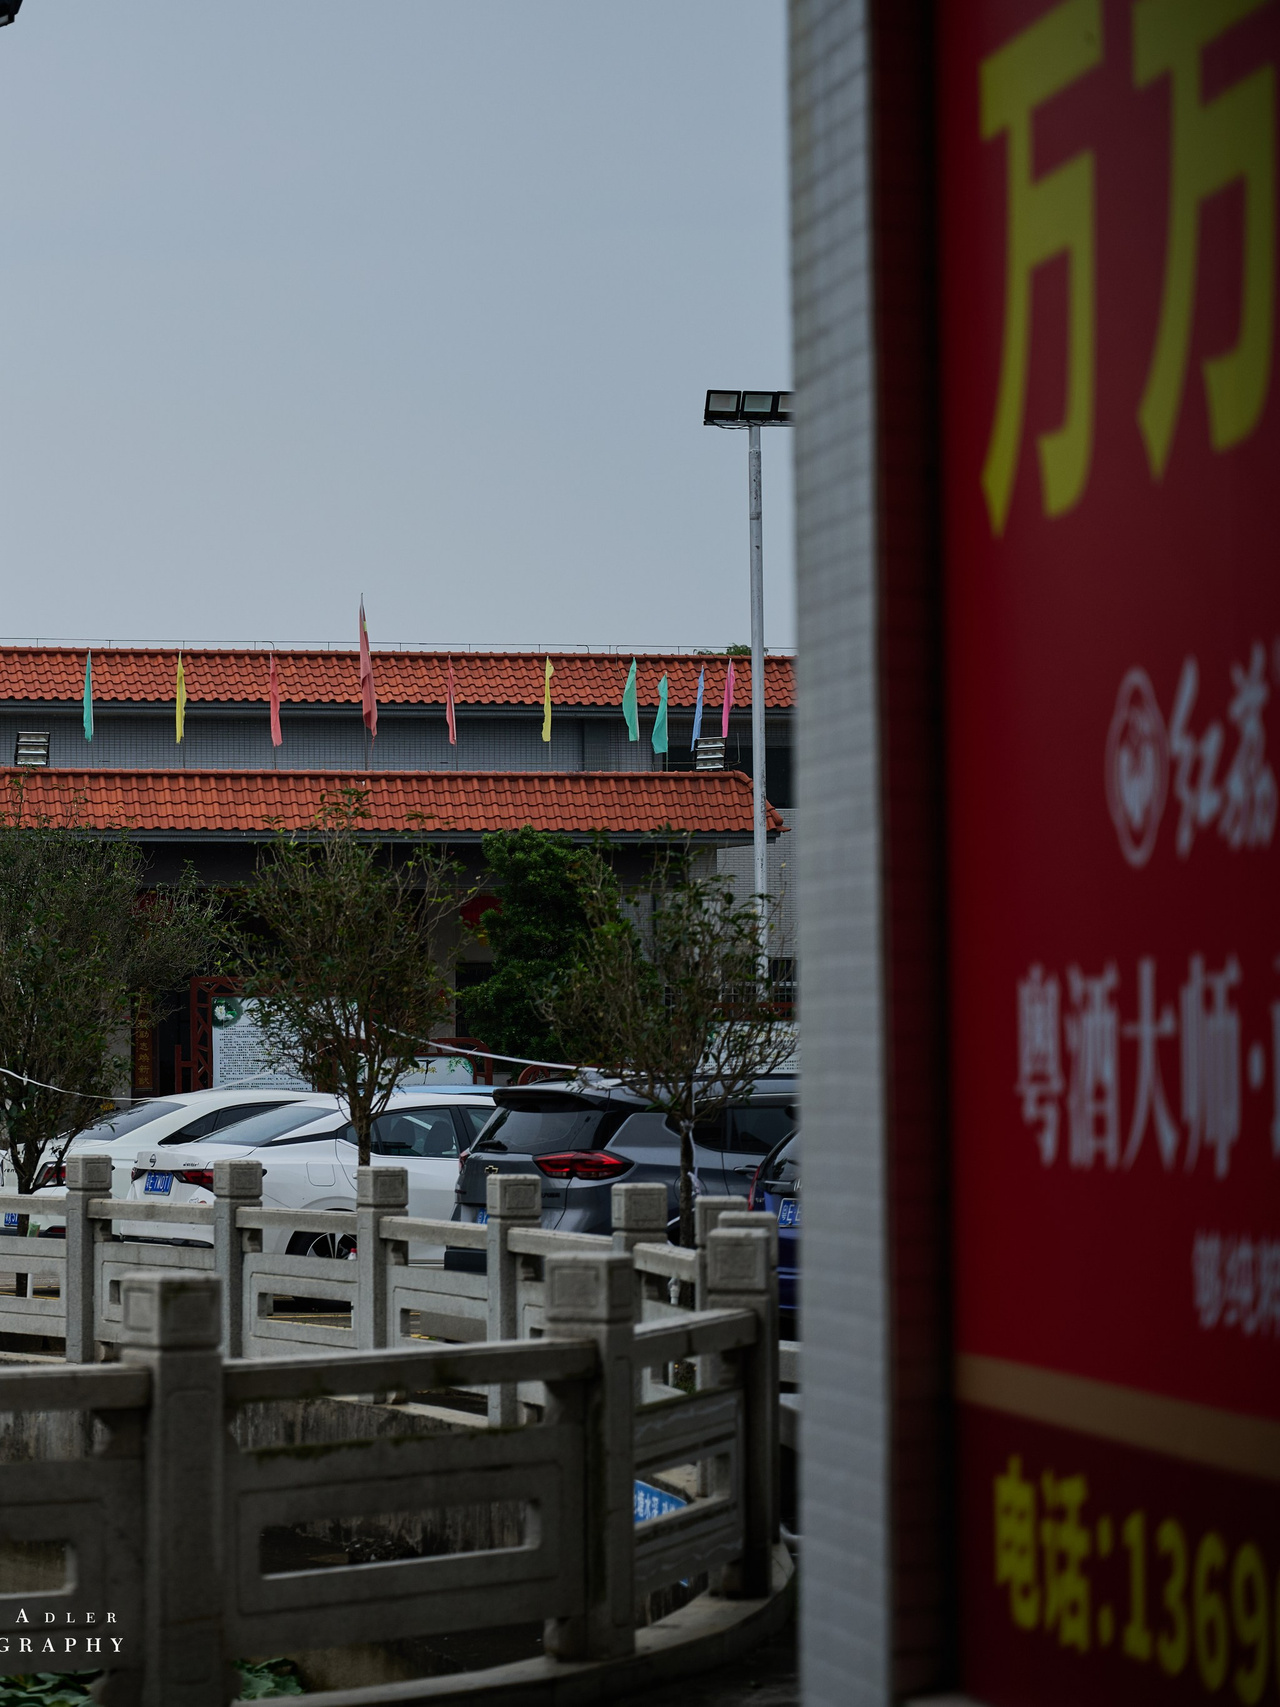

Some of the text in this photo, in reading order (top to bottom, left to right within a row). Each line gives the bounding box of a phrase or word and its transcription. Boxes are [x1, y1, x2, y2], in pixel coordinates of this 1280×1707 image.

[1170, 634, 1280, 864] 红荔
[1017, 951, 1280, 1182] 粤酒大师·
